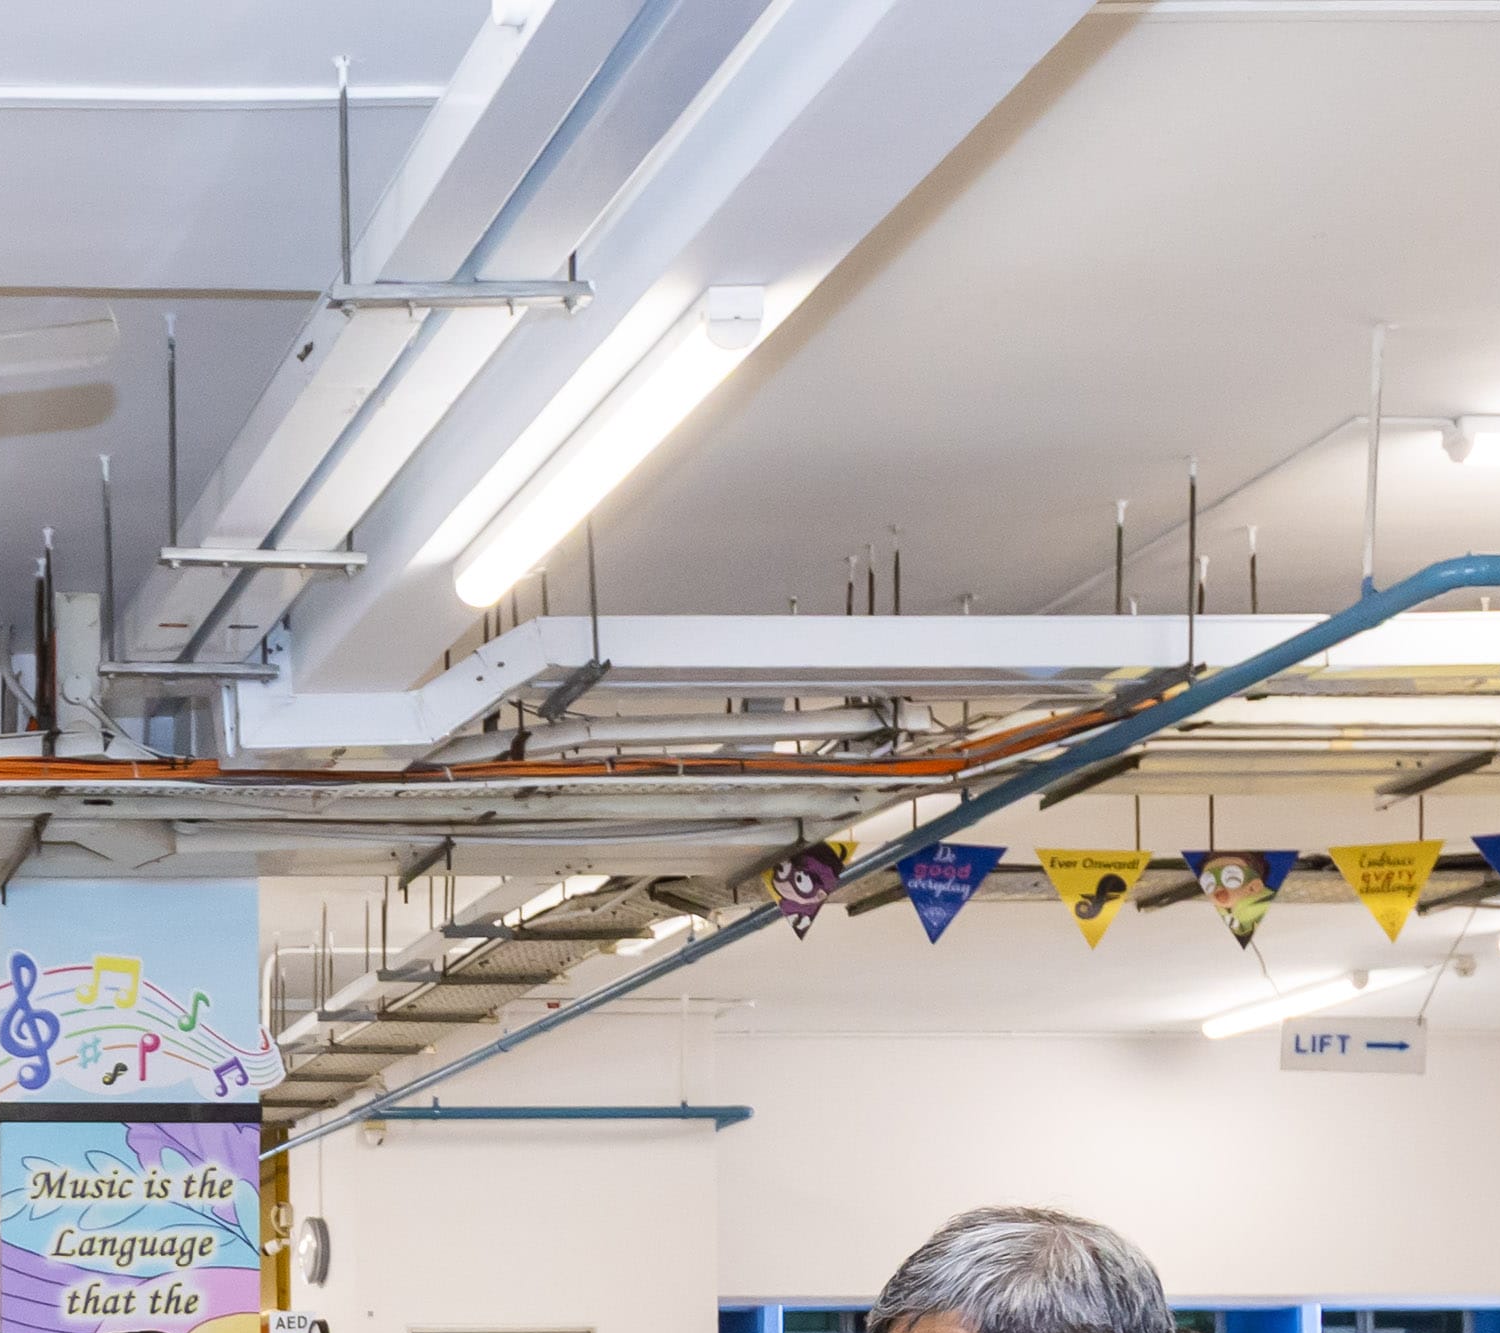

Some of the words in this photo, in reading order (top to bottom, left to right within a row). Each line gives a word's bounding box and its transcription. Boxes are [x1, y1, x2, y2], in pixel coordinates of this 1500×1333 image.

[913, 863, 973, 879] good
[1049, 856, 1078, 869] Ever
[1082, 857, 1140, 869] Onward!
[907, 876, 971, 900] everyday
[1361, 870, 1417, 890] every
[1294, 1034, 1351, 1054] LIFT
[30, 1168, 134, 1200] Music
[144, 1170, 172, 1200] is
[183, 1166, 234, 1200] the
[52, 1228, 214, 1268] Language
[68, 1283, 136, 1315] that
[149, 1282, 200, 1315] the
[275, 1315, 308, 1330] AED
